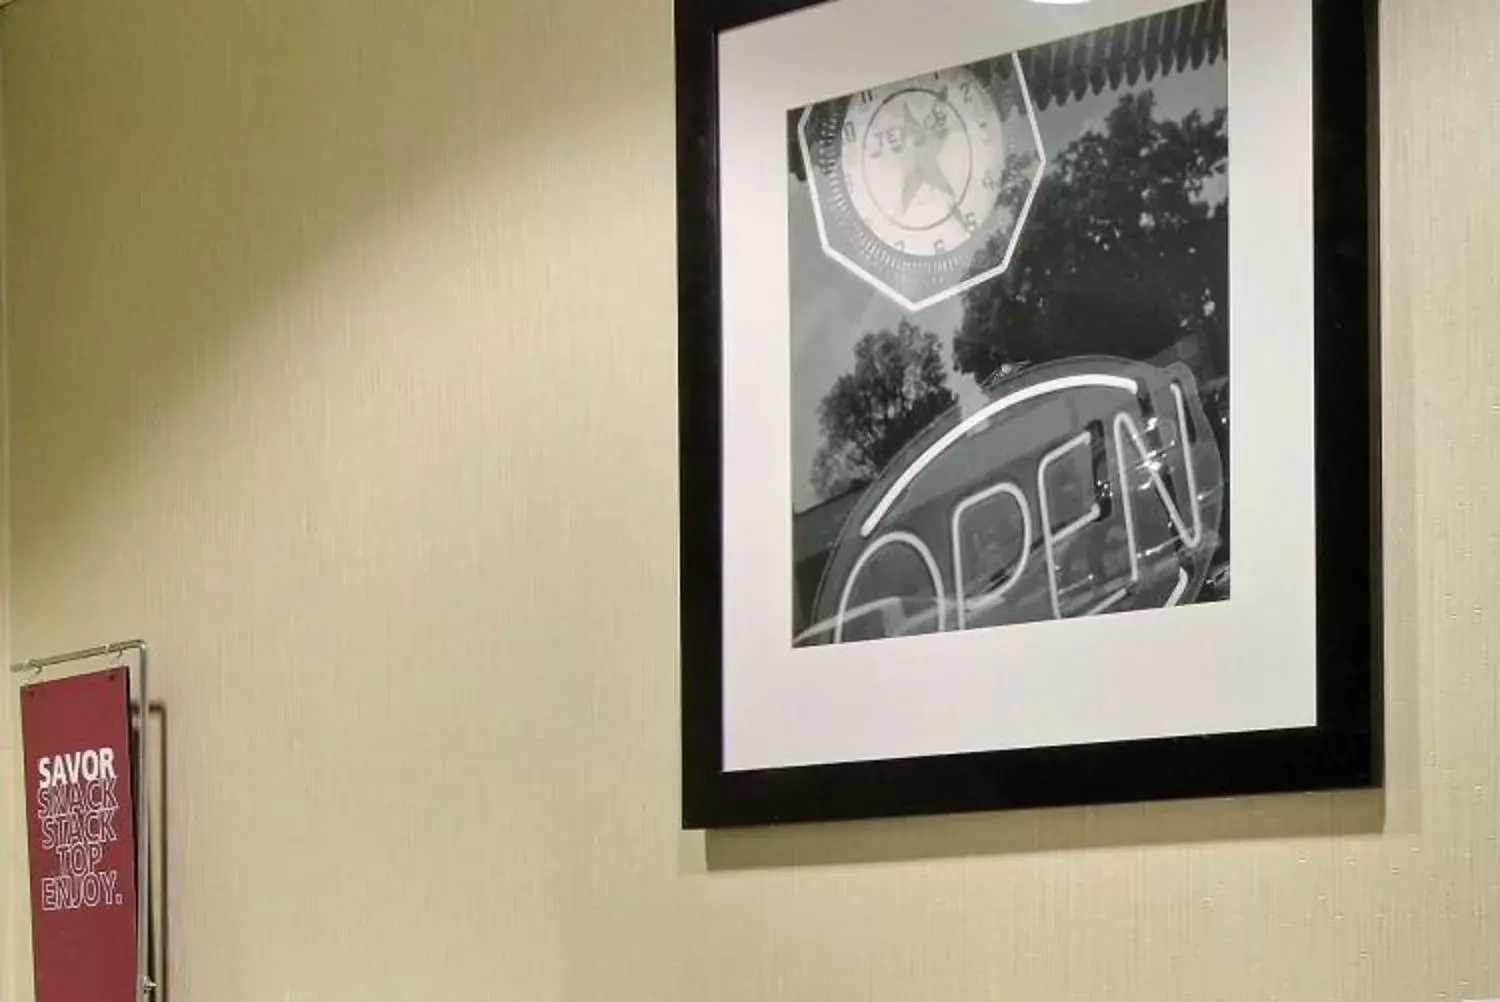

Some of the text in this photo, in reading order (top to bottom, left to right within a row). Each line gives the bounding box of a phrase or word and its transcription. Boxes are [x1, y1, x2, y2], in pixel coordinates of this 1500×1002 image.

[38, 747, 117, 789] SAVOR
[38, 776, 119, 820] SNACK
[41, 808, 117, 851] STACK
[56, 842, 104, 878] TOP
[41, 870, 123, 911] ENJOY.
